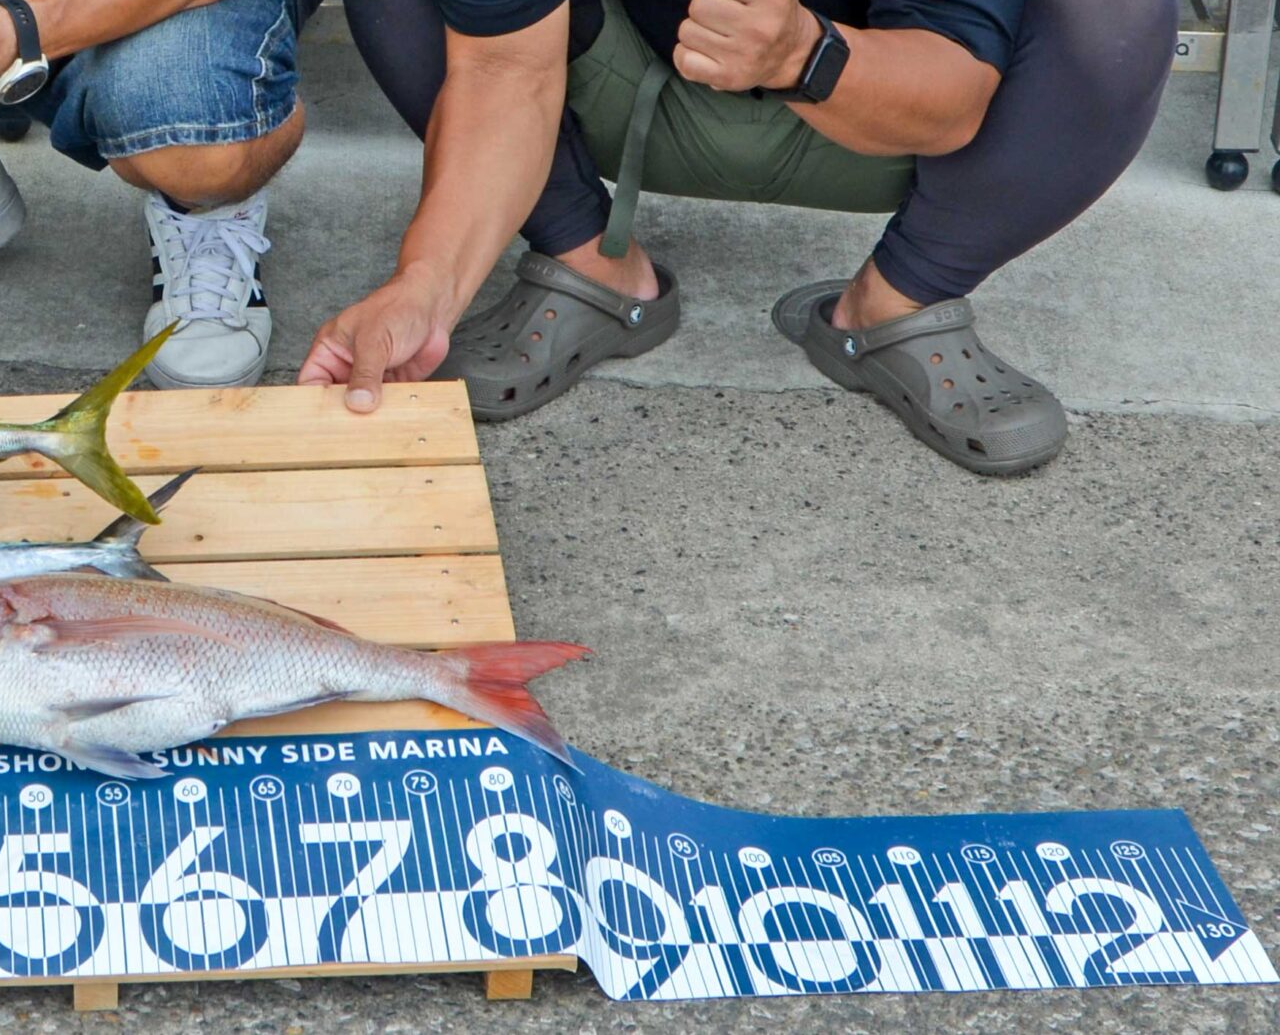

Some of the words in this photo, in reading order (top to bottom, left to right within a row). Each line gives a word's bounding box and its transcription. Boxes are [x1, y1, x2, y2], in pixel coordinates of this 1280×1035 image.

[152, 745, 268, 768] SUNNY
[280, 742, 357, 764] SIDE
[368, 736, 509, 761] MARINA
[28, 790, 45, 802] 50
[104, 788, 123, 801] 55
[182, 784, 199, 797] 60
[258, 782, 276, 795] 65
[336, 779, 352, 791] 70
[411, 776, 429, 790] 75
[488, 773, 505, 785] 80
[610, 816, 625, 832] 90
[674, 839, 692, 854] 95
[744, 852, 766, 863] 100
[817, 853, 842, 863] 105
[892, 851, 916, 861] 110
[966, 849, 991, 859] 115
[1042, 847, 1065, 857] 120
[1115, 845, 1140, 856] 125
[138, 826, 270, 971] 6
[299, 819, 413, 962] 7
[462, 813, 583, 957] 8
[585, 856, 690, 1000] 9
[689, 884, 882, 997] 10
[867, 881, 1007, 992] 11
[997, 877, 1200, 988] 12
[1197, 923, 1235, 939] 130
